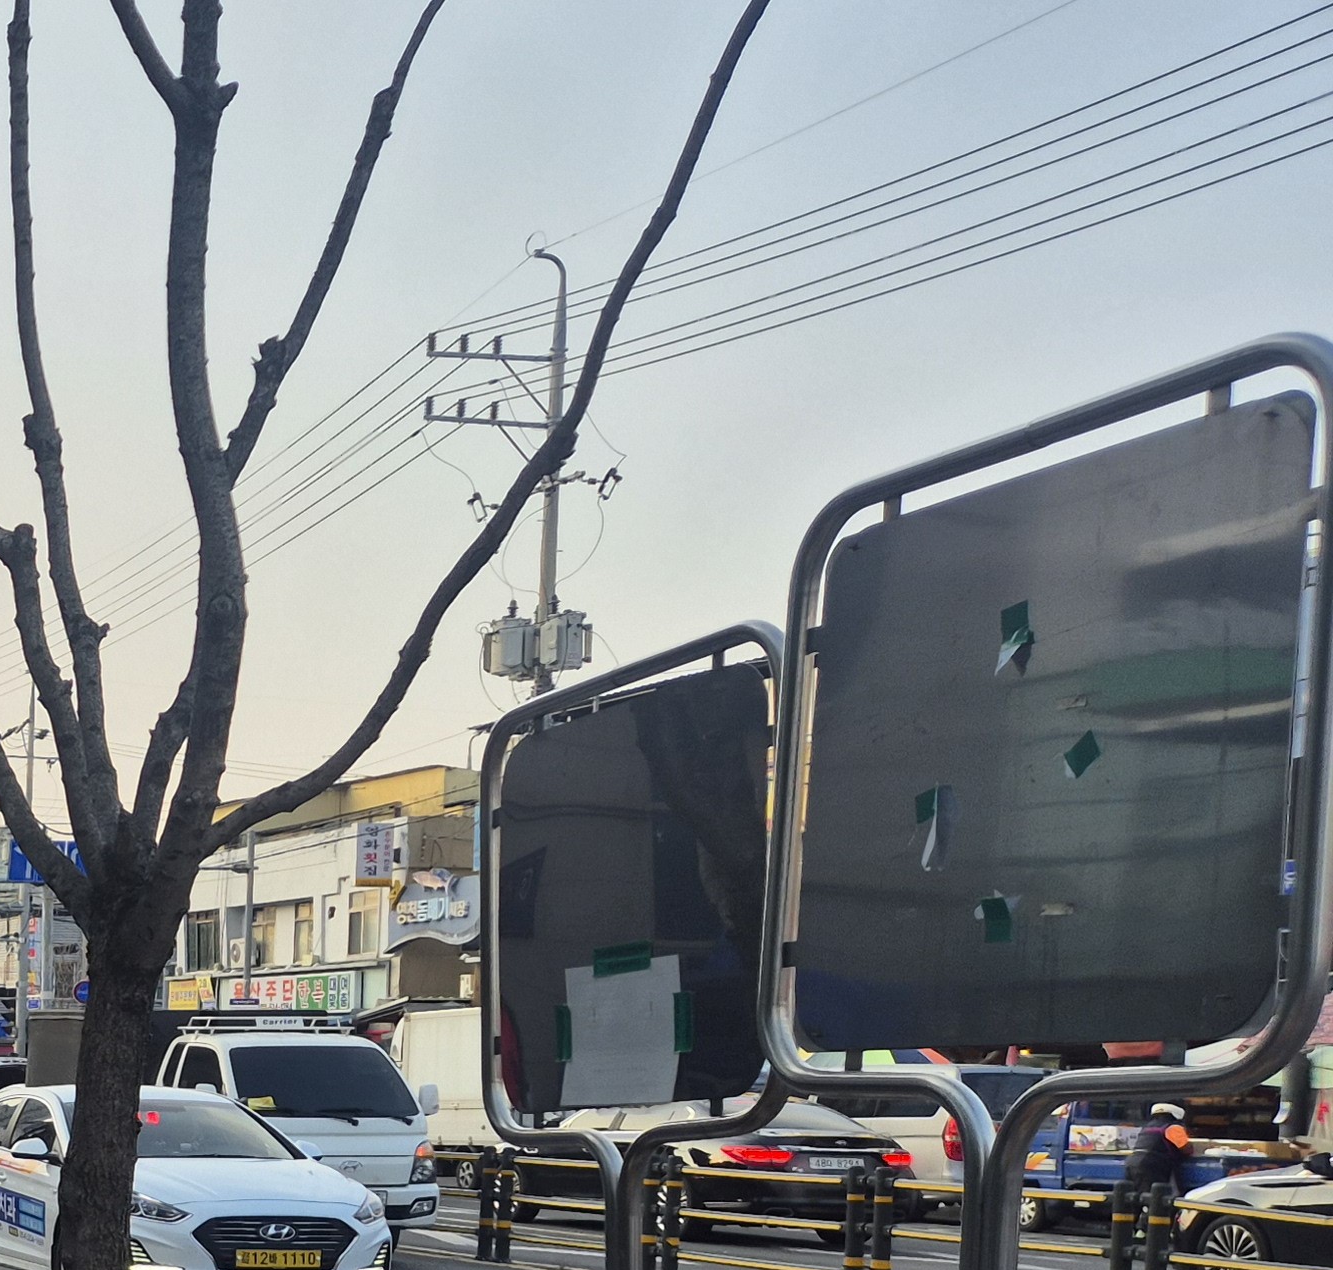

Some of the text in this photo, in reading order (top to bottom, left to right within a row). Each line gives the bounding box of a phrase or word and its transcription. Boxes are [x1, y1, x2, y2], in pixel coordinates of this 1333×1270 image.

[298, 978, 325, 1009] 한복
[262, 1018, 298, 1026] Carrier
[282, 1252, 316, 1265] 1110
